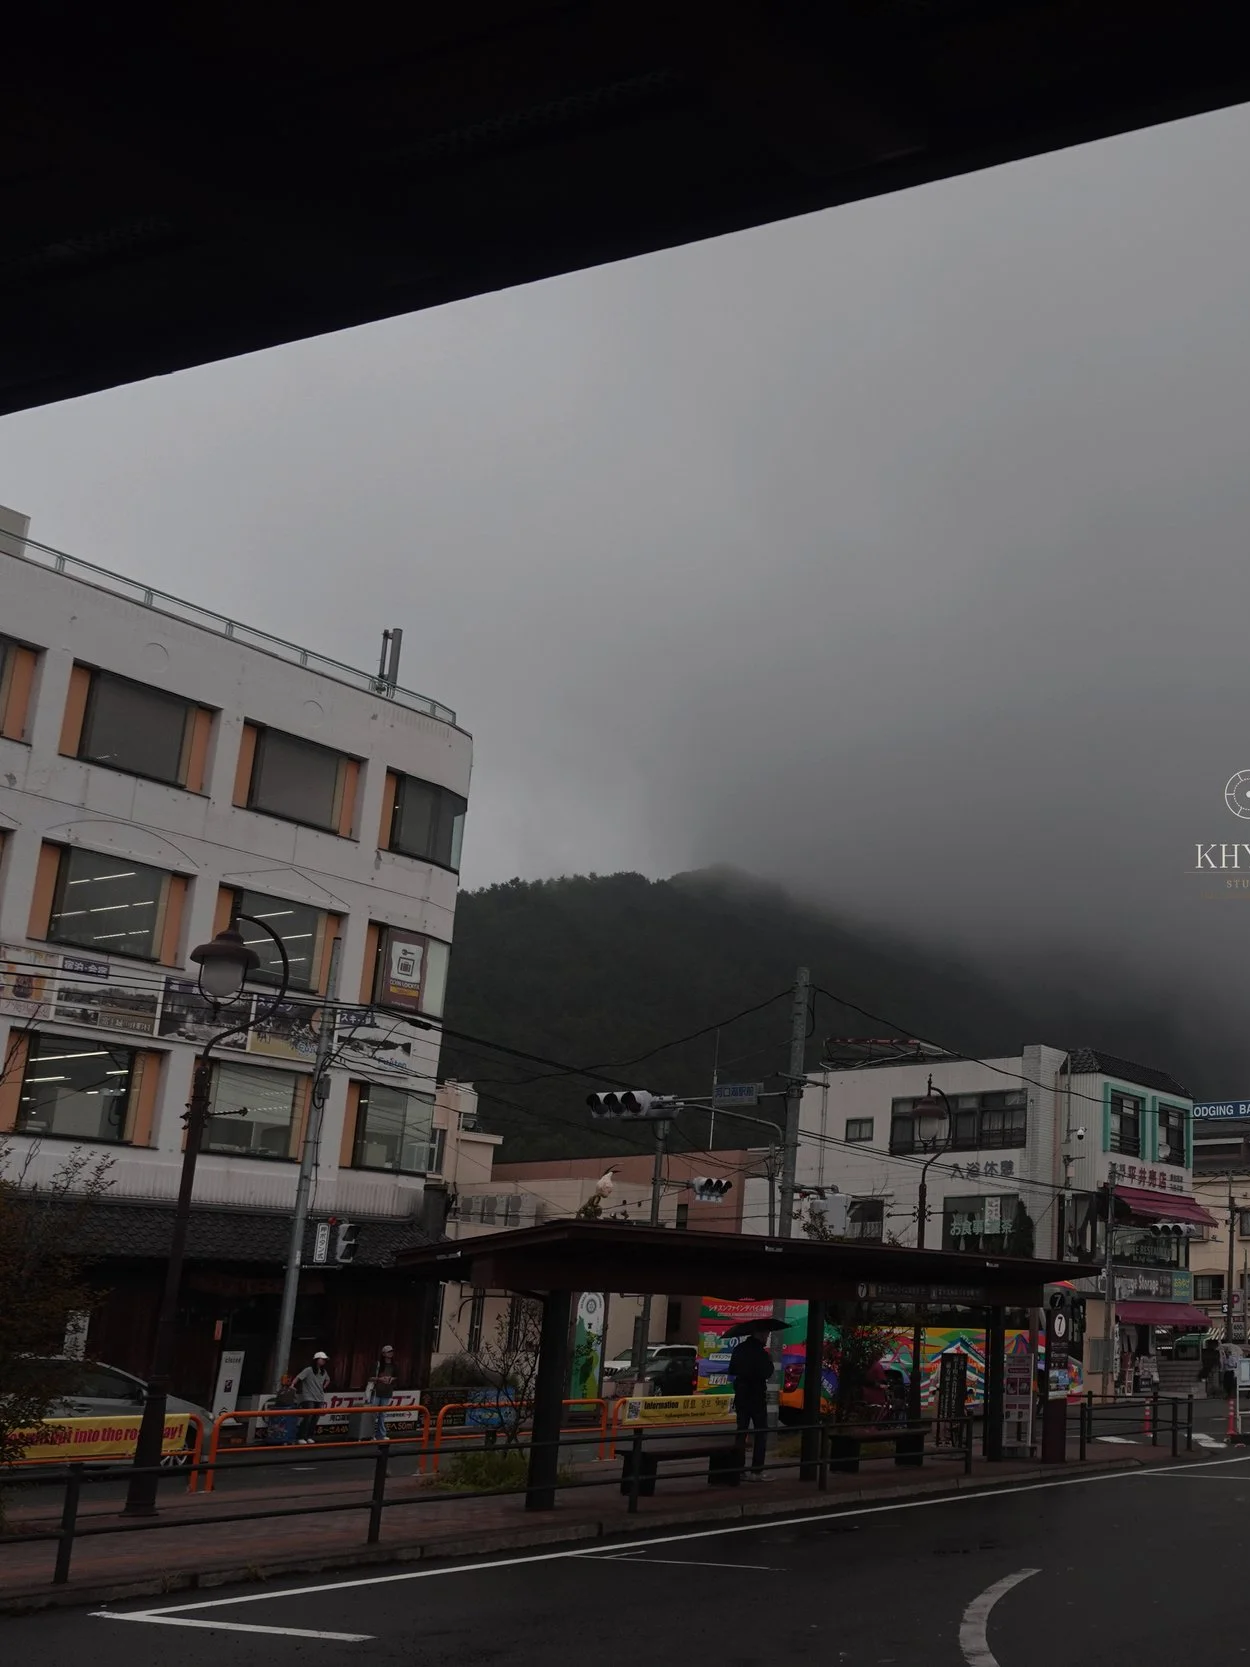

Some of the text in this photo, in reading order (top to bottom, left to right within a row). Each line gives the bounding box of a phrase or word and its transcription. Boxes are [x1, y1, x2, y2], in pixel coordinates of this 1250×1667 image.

[1192, 1105, 1234, 1118] ODGING
[1053, 1294, 1062, 1307] 7
[644, 1400, 679, 1410] Information
[74, 1427, 100, 1443] into
[102, 1426, 122, 1442] the
